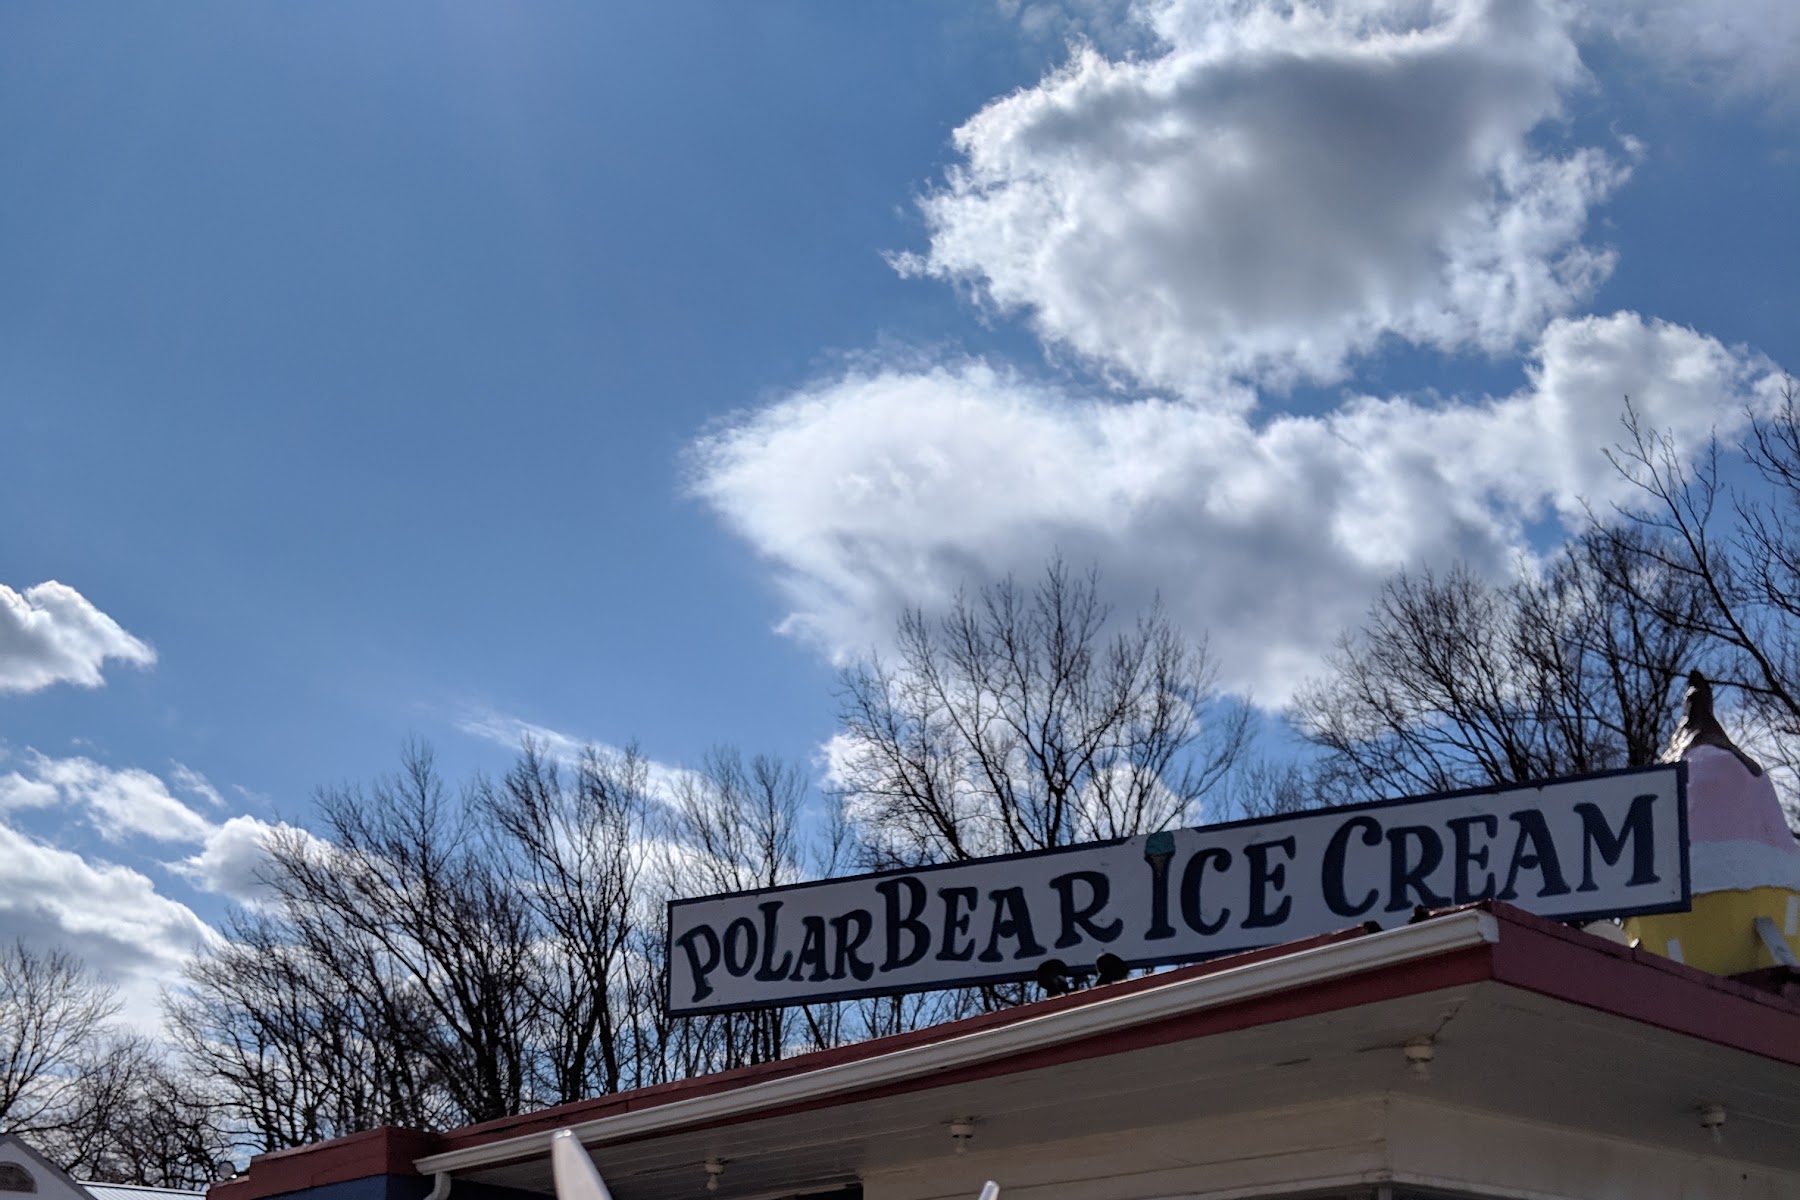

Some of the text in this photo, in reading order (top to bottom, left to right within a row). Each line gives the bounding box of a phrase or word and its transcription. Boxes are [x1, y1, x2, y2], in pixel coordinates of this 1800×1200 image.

[875, 869, 1124, 974] BEAR
[1144, 831, 1297, 941] ICE
[1321, 793, 1662, 917] CREAM
